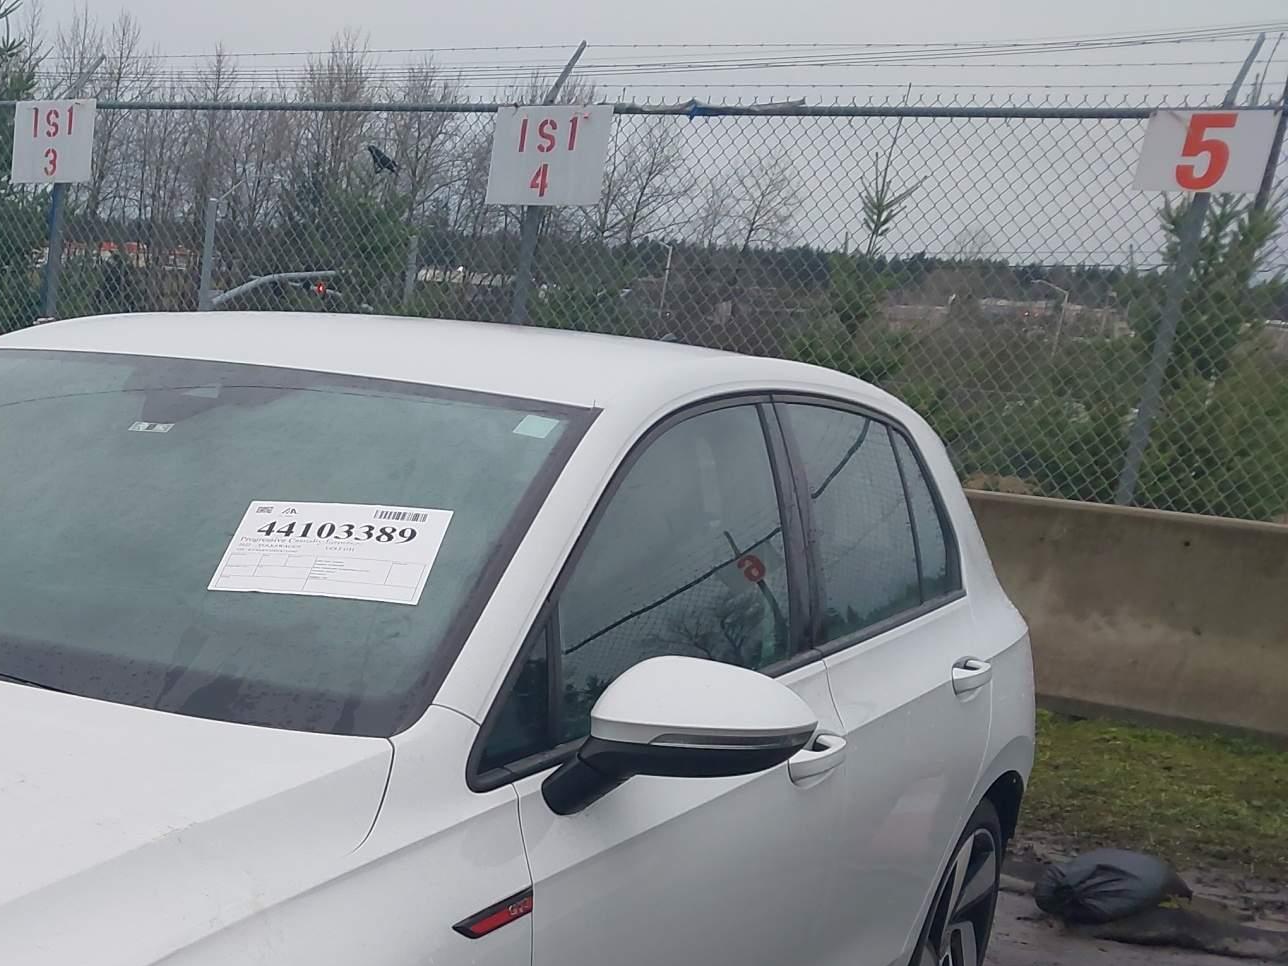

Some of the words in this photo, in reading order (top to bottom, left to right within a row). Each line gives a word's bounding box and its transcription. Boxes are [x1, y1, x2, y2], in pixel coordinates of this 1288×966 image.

[44, 148, 57, 176] 3
[1175, 112, 1239, 191] 5
[529, 163, 549, 197] 4
[256, 520, 418, 545] 44103389
